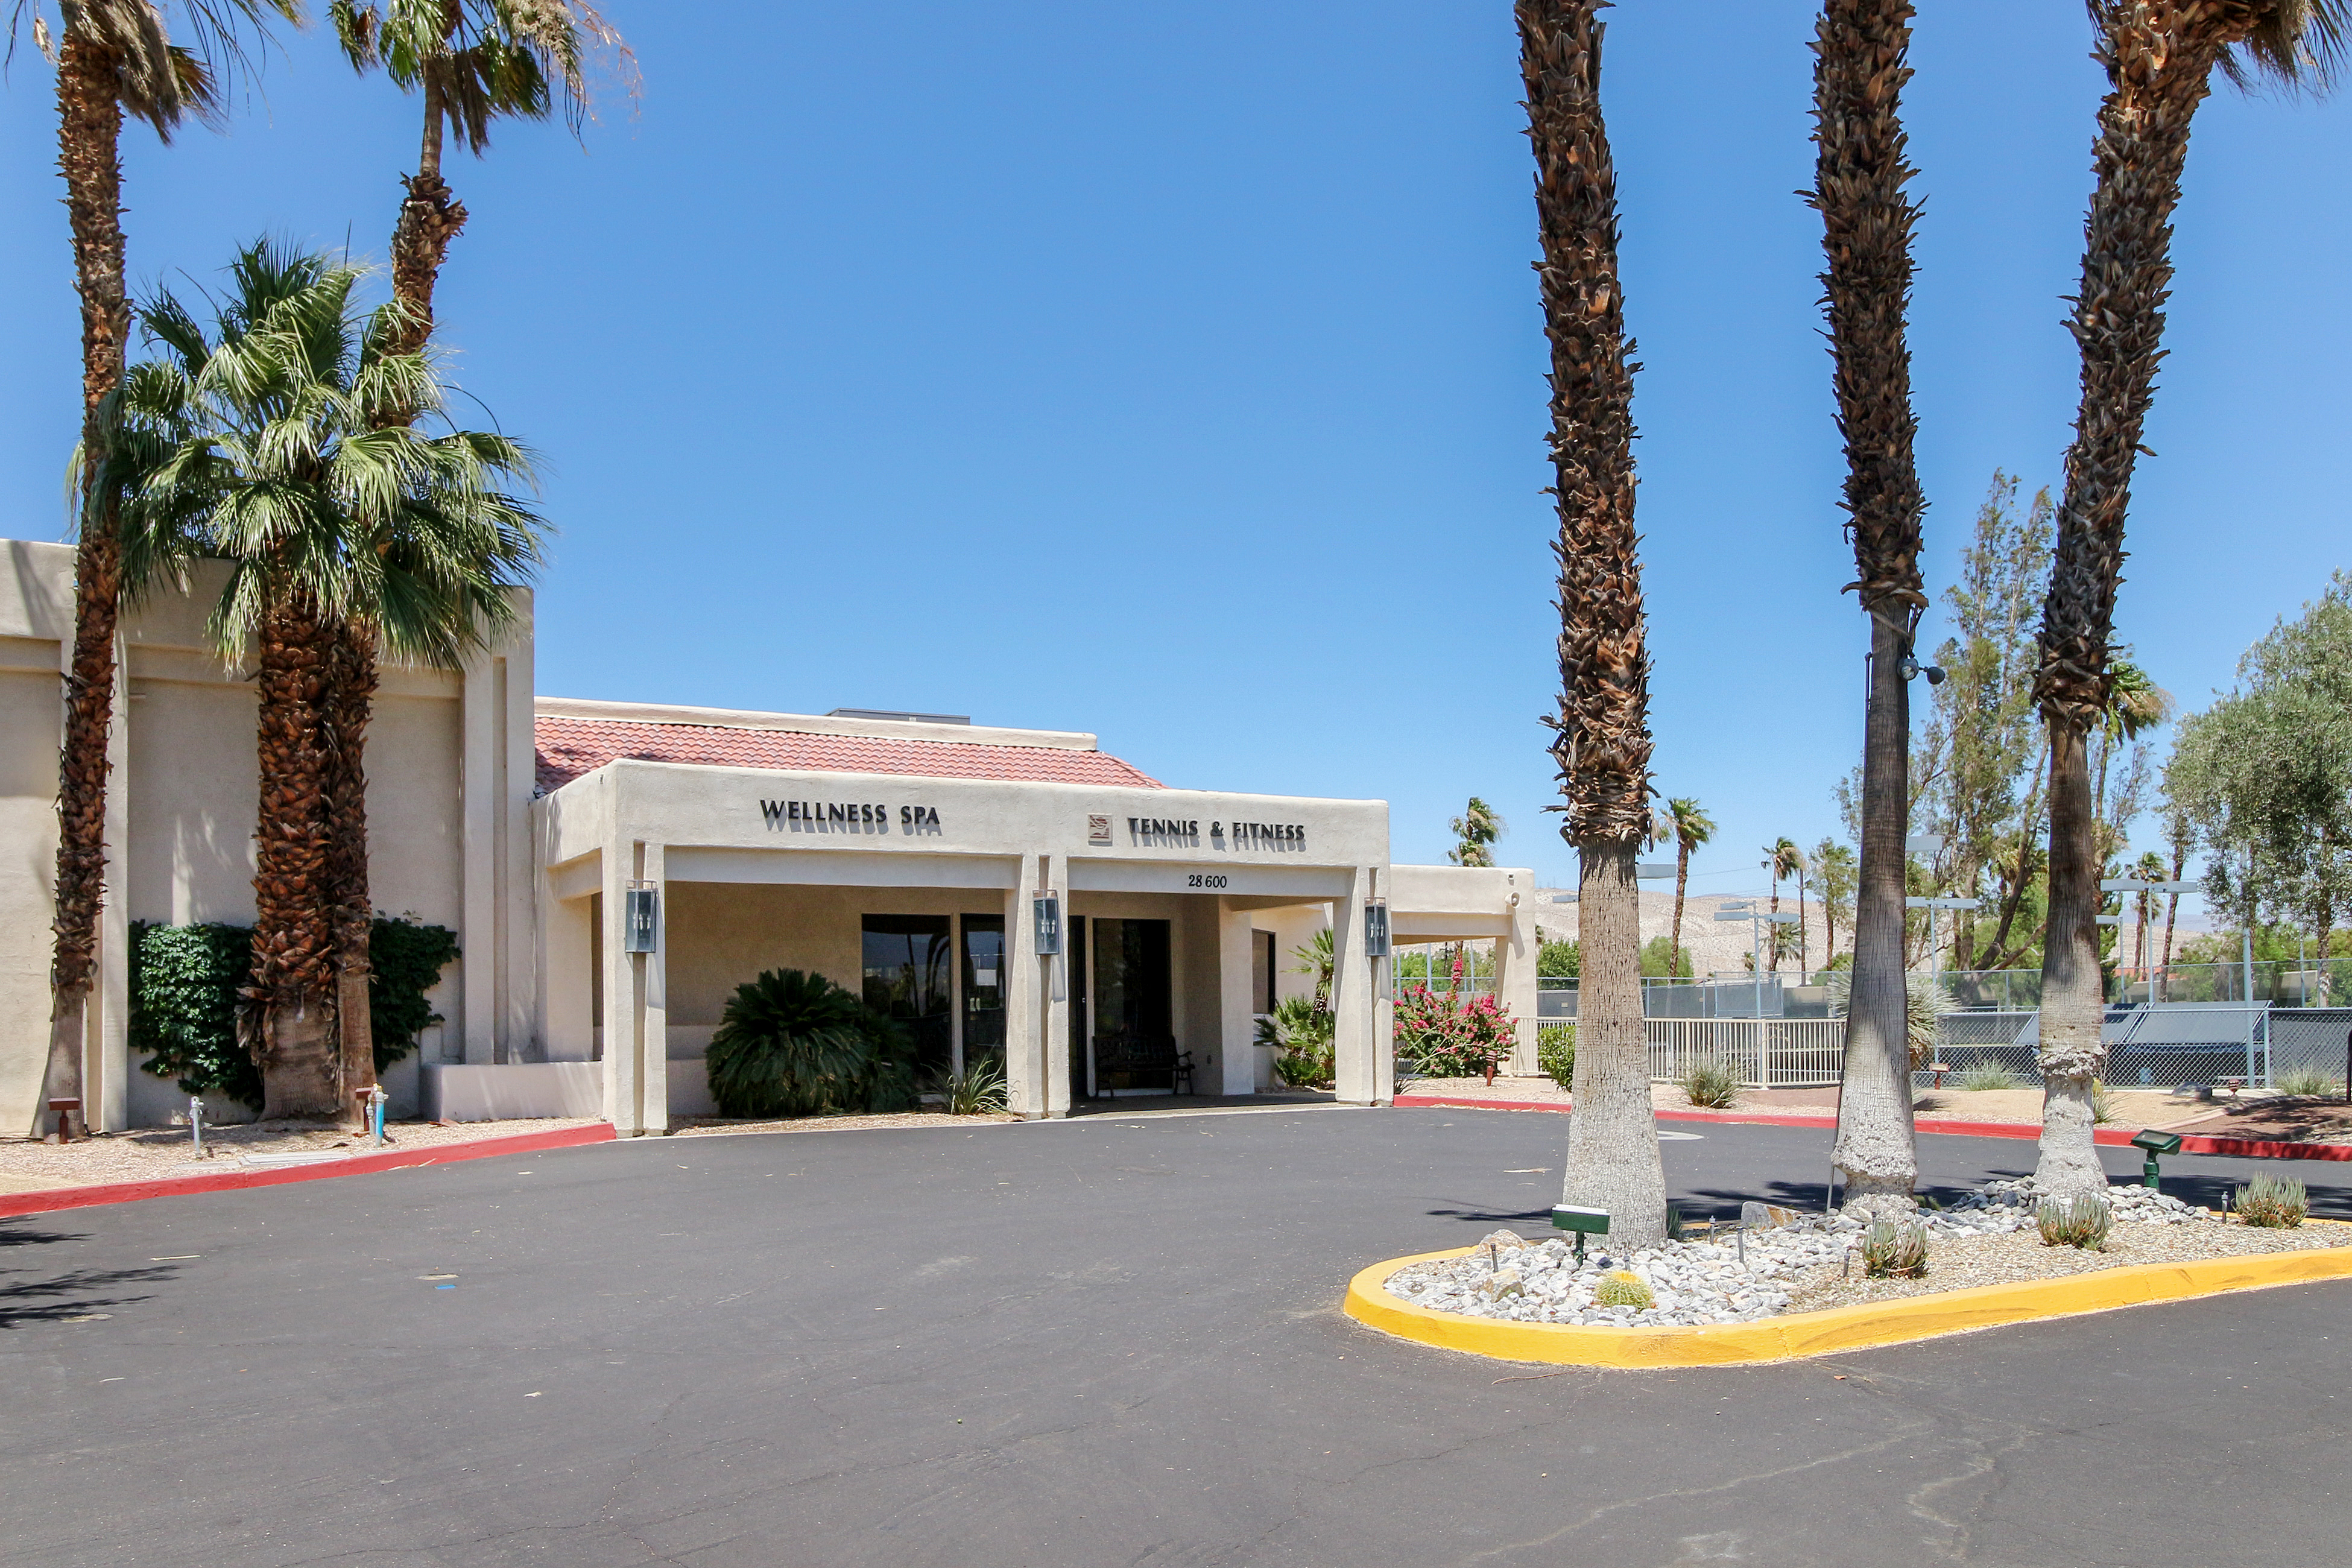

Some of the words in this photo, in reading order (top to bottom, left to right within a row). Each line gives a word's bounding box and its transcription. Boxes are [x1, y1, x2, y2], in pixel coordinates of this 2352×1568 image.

[760, 800, 887, 823] WELLNESS
[900, 806, 940, 824] SPA
[1128, 817, 1198, 836] TENNIS
[1210, 821, 1224, 837] &
[1232, 822, 1304, 840] FITNESS
[1188, 874, 1227, 888] 28600
